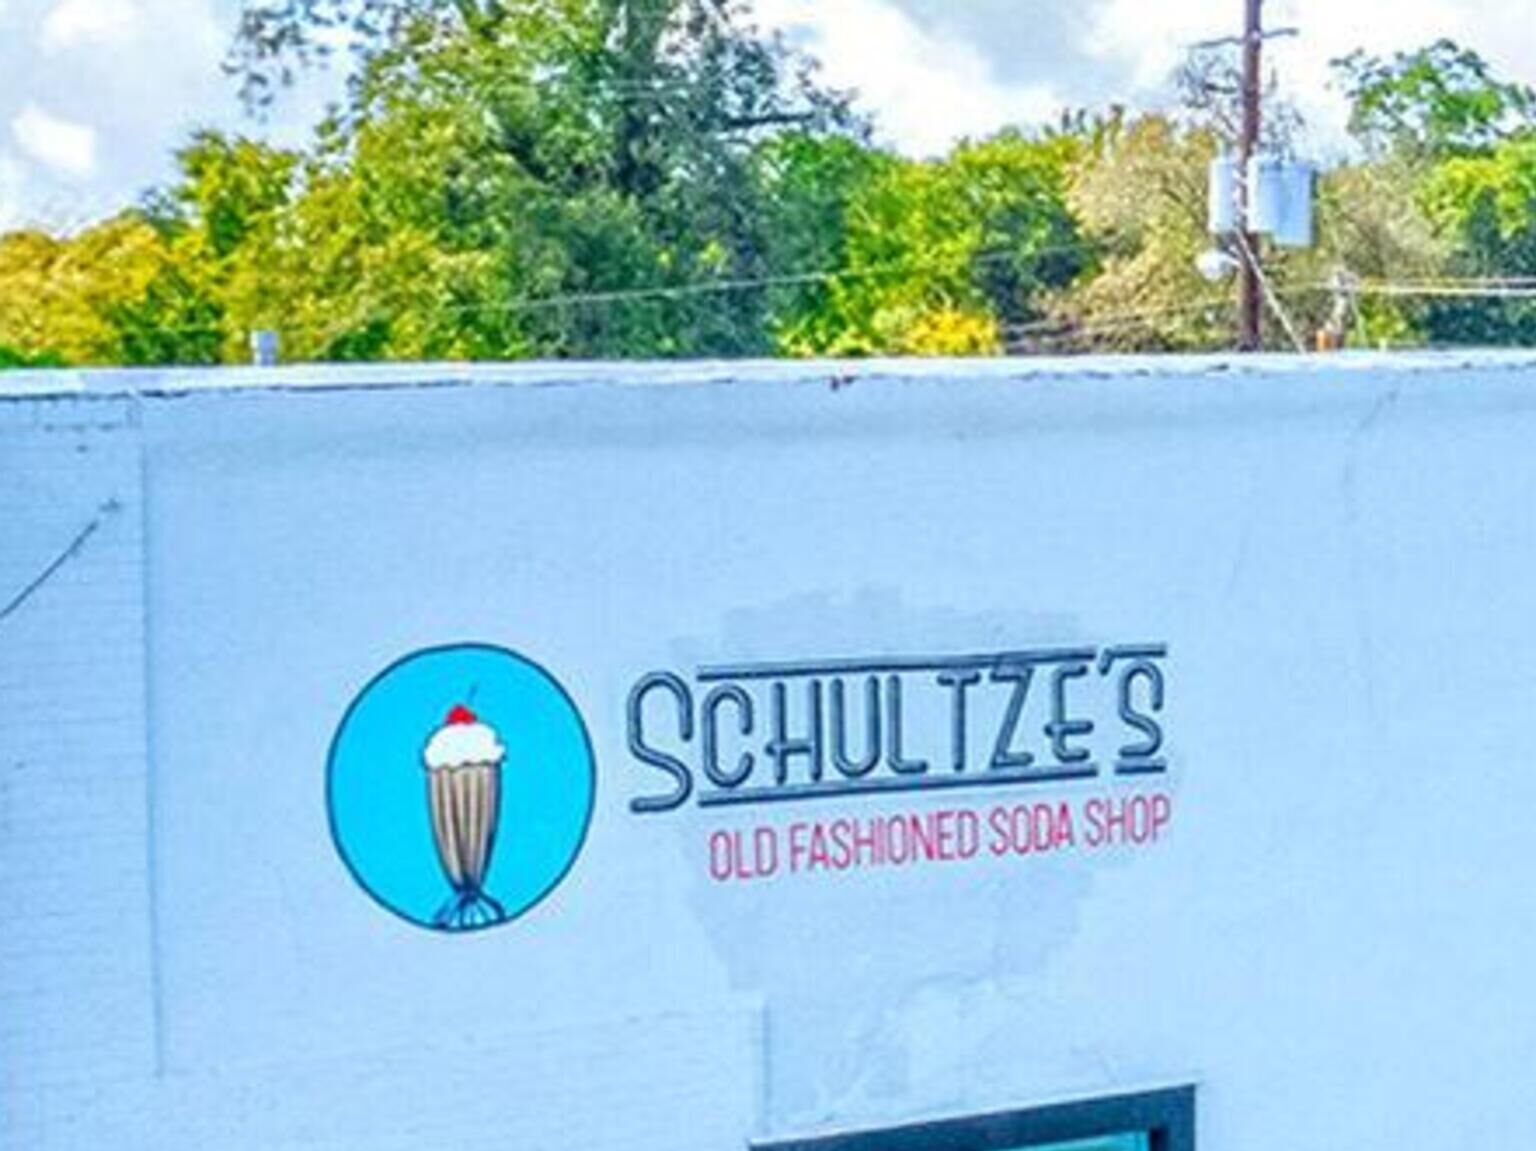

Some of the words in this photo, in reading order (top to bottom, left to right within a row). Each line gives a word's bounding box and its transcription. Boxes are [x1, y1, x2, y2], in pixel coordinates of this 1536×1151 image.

[628, 645, 1167, 812] SCHULTZE'S
[709, 826, 778, 881] OLD
[789, 809, 980, 873] FASHIONED
[988, 802, 1075, 856] SODA
[1084, 794, 1171, 848] SHOP
